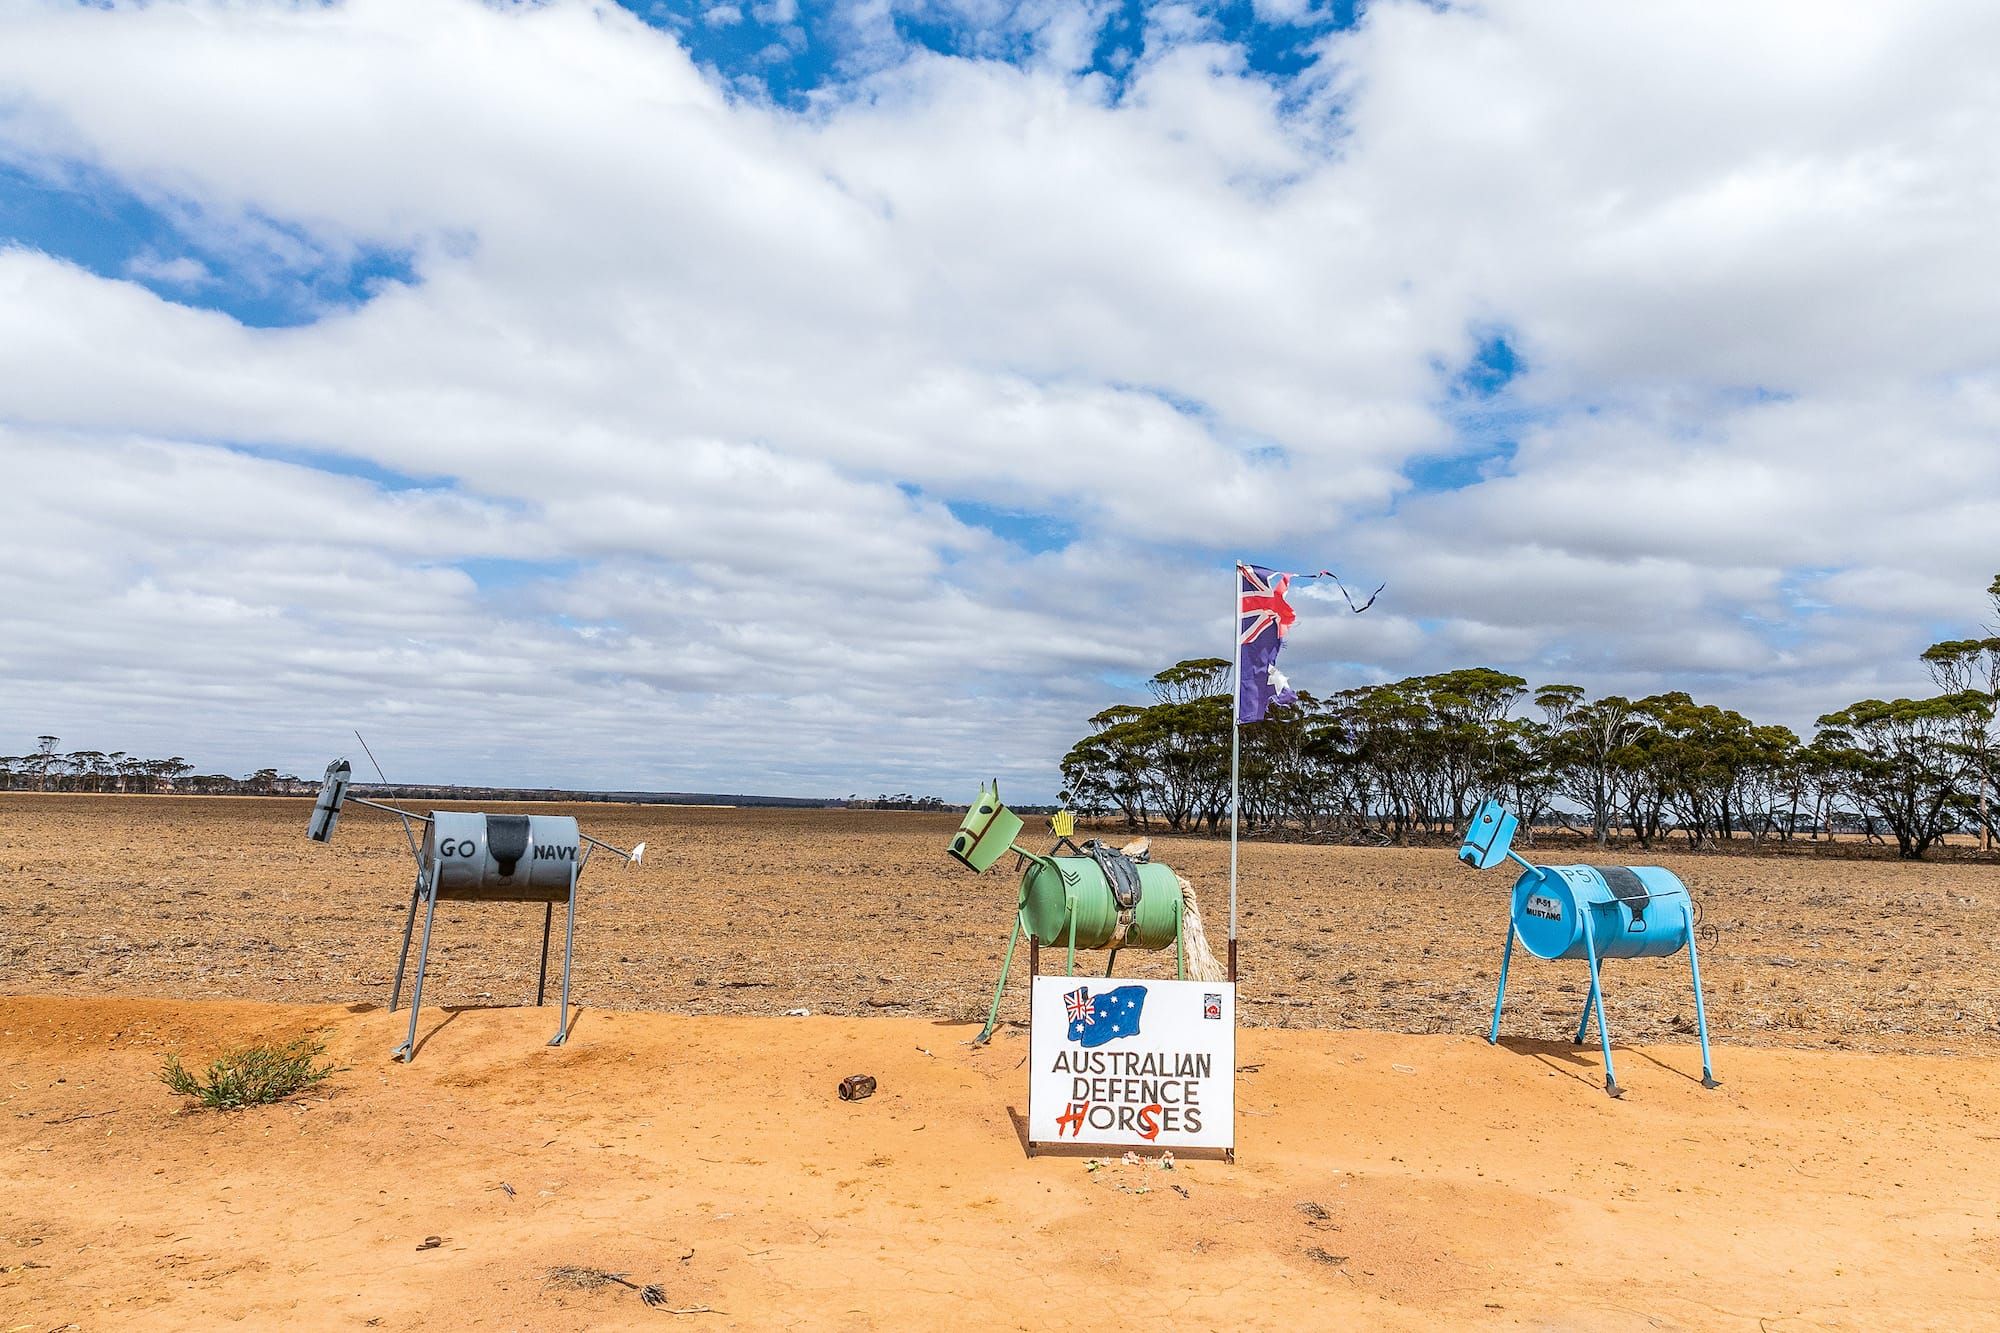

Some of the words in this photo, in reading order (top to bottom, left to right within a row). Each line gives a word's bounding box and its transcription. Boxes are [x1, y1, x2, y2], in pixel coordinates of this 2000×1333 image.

[440, 838, 476, 858] GO
[534, 845, 578, 860] NAVY
[1526, 908, 1561, 921] MUSTANG
[1536, 898, 1551, 908] P-51
[1052, 1050, 1211, 1078] AUSTRALIAN
[1072, 1077, 1199, 1106] DEFENCE
[1056, 1100, 1203, 1142] HORSES
